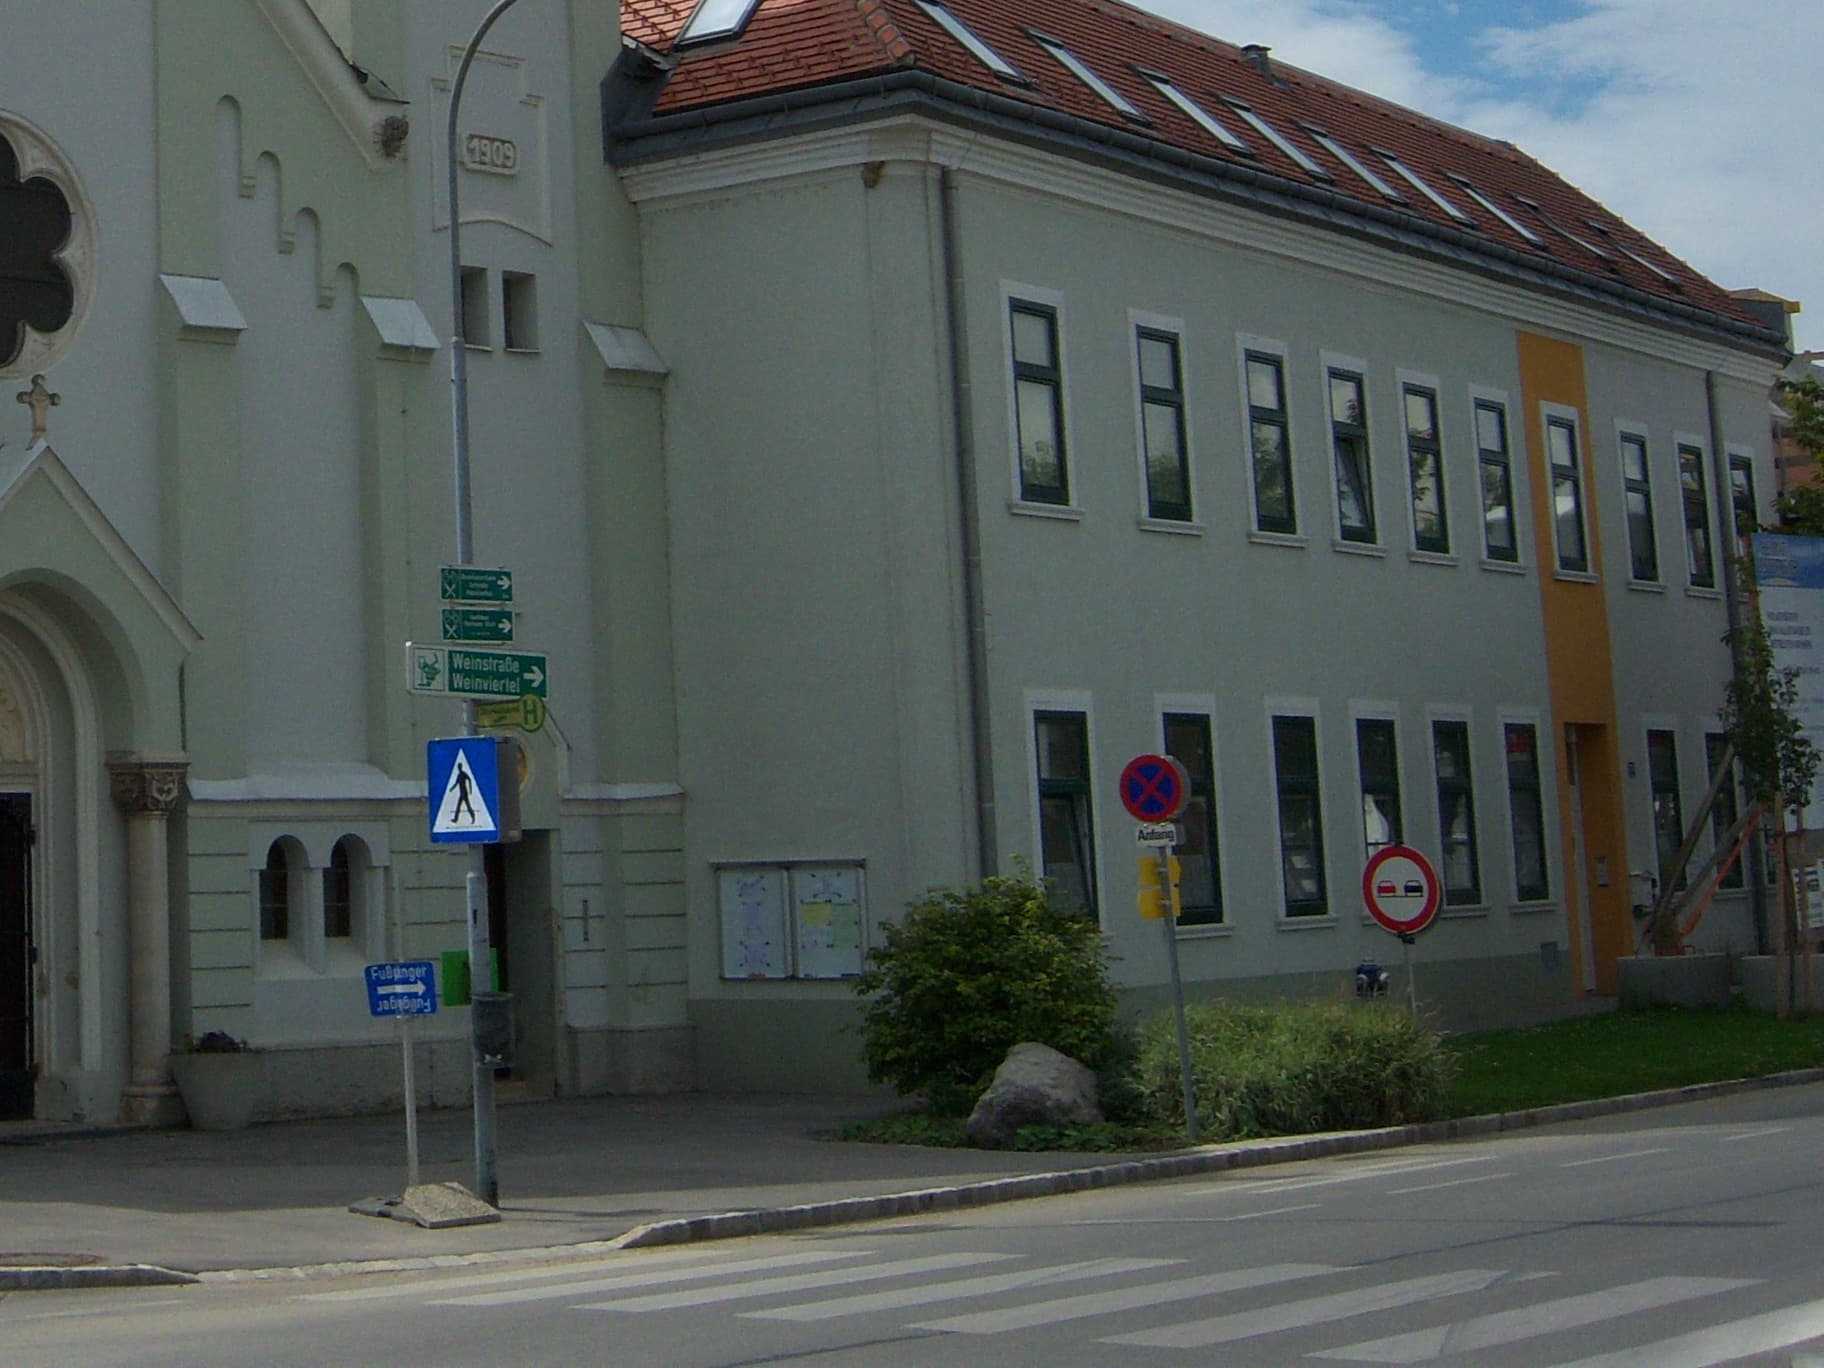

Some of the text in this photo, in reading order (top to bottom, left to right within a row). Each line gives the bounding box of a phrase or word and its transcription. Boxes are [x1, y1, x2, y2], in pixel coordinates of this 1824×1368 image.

[468, 138, 514, 167] 1909
[452, 653, 520, 673] Weinstraße
[452, 672, 521, 694] Weinviertel
[522, 699, 538, 725] H
[1138, 828, 1175, 842] Anfang
